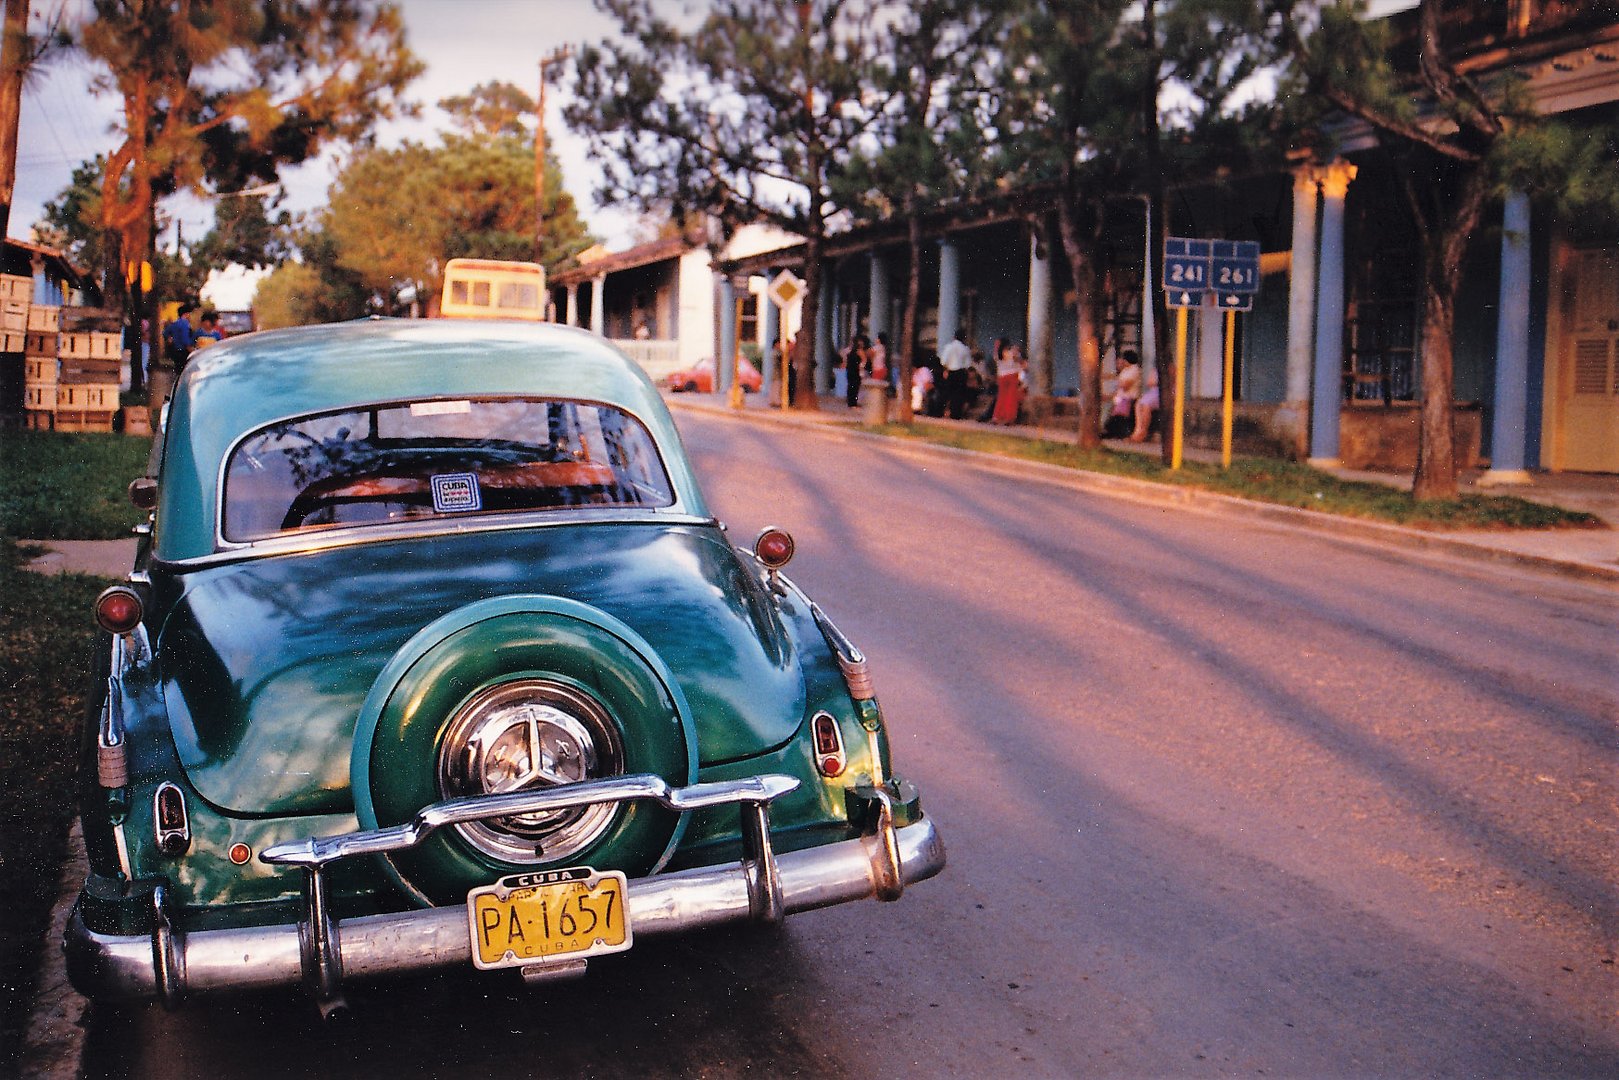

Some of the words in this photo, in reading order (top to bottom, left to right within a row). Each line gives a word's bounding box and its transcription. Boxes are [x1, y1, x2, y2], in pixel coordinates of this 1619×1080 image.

[1171, 264, 1203, 282] 241
[1220, 267, 1253, 285] 261
[442, 482, 468, 491] CUBA
[518, 871, 573, 886] CUBA
[524, 939, 580, 955] CUBA
